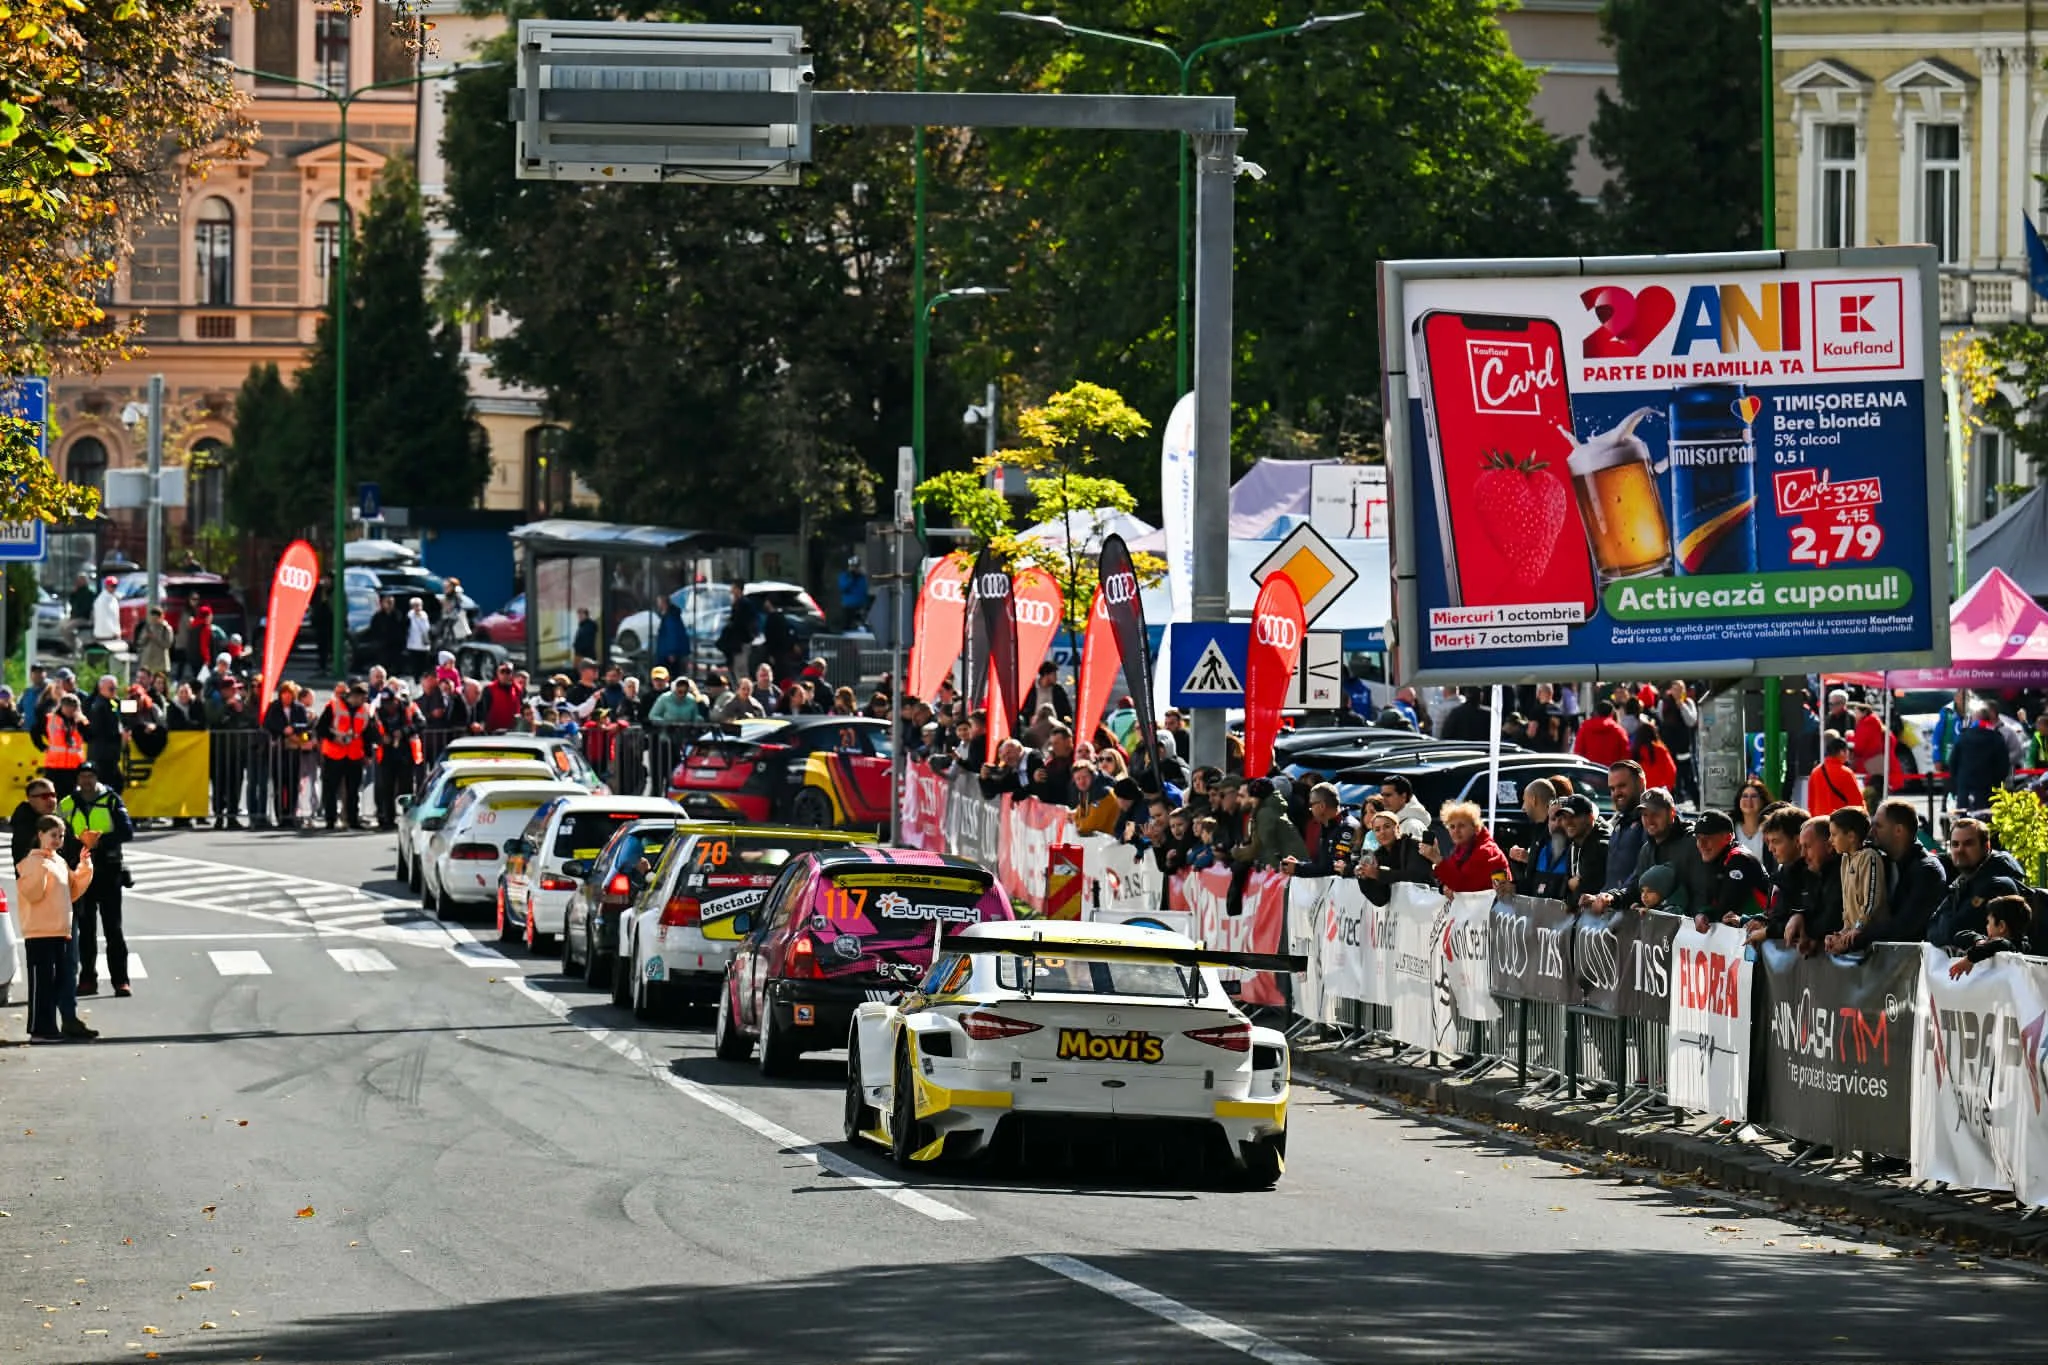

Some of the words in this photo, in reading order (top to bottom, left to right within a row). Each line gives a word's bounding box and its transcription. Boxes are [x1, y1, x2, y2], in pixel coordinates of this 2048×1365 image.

[1672, 282, 1802, 356] ANI
[1473, 346, 1509, 357] Kaufland
[1823, 340, 1894, 356] Kaufland
[1481, 346, 1559, 406] Card
[1583, 365, 1647, 383] PARTE
[1653, 363, 1688, 380] DIN
[1692, 359, 1774, 378] FAMILIA
[1779, 359, 1804, 375] TA
[1773, 391, 1907, 414] TIMIȘOREANA
[1774, 415, 1816, 432] Bere
[1819, 412, 1881, 429] blondă
[1774, 434, 1796, 447] 5%
[1800, 432, 1841, 446] alcool
[1774, 450, 1797, 465] 0,5
[1783, 468, 1830, 509] Card
[1824, 485, 1879, 504] -32%
[1836, 508, 1870, 524] 4,15
[1791, 524, 1881, 565] 2,79
[1617, 581, 1766, 611] Activează
[1774, 576, 1899, 609] cuponul!
[1433, 610, 1494, 625] Miercuri
[1497, 610, 1504, 622] 1
[1507, 607, 1581, 622] octombrie
[1705, 623, 1723, 633] prin
[1869, 615, 1914, 624] Kaufland
[1434, 633, 1475, 649] Marți
[1479, 633, 1487, 644] 7
[1490, 630, 1564, 645] octombrie
[1611, 635, 1634, 645] Card
[696, 841, 728, 865] 70
[824, 888, 868, 920] 117
[1060, 1031, 1162, 1062] Movi's
[1827, 1069, 1888, 1098] services
